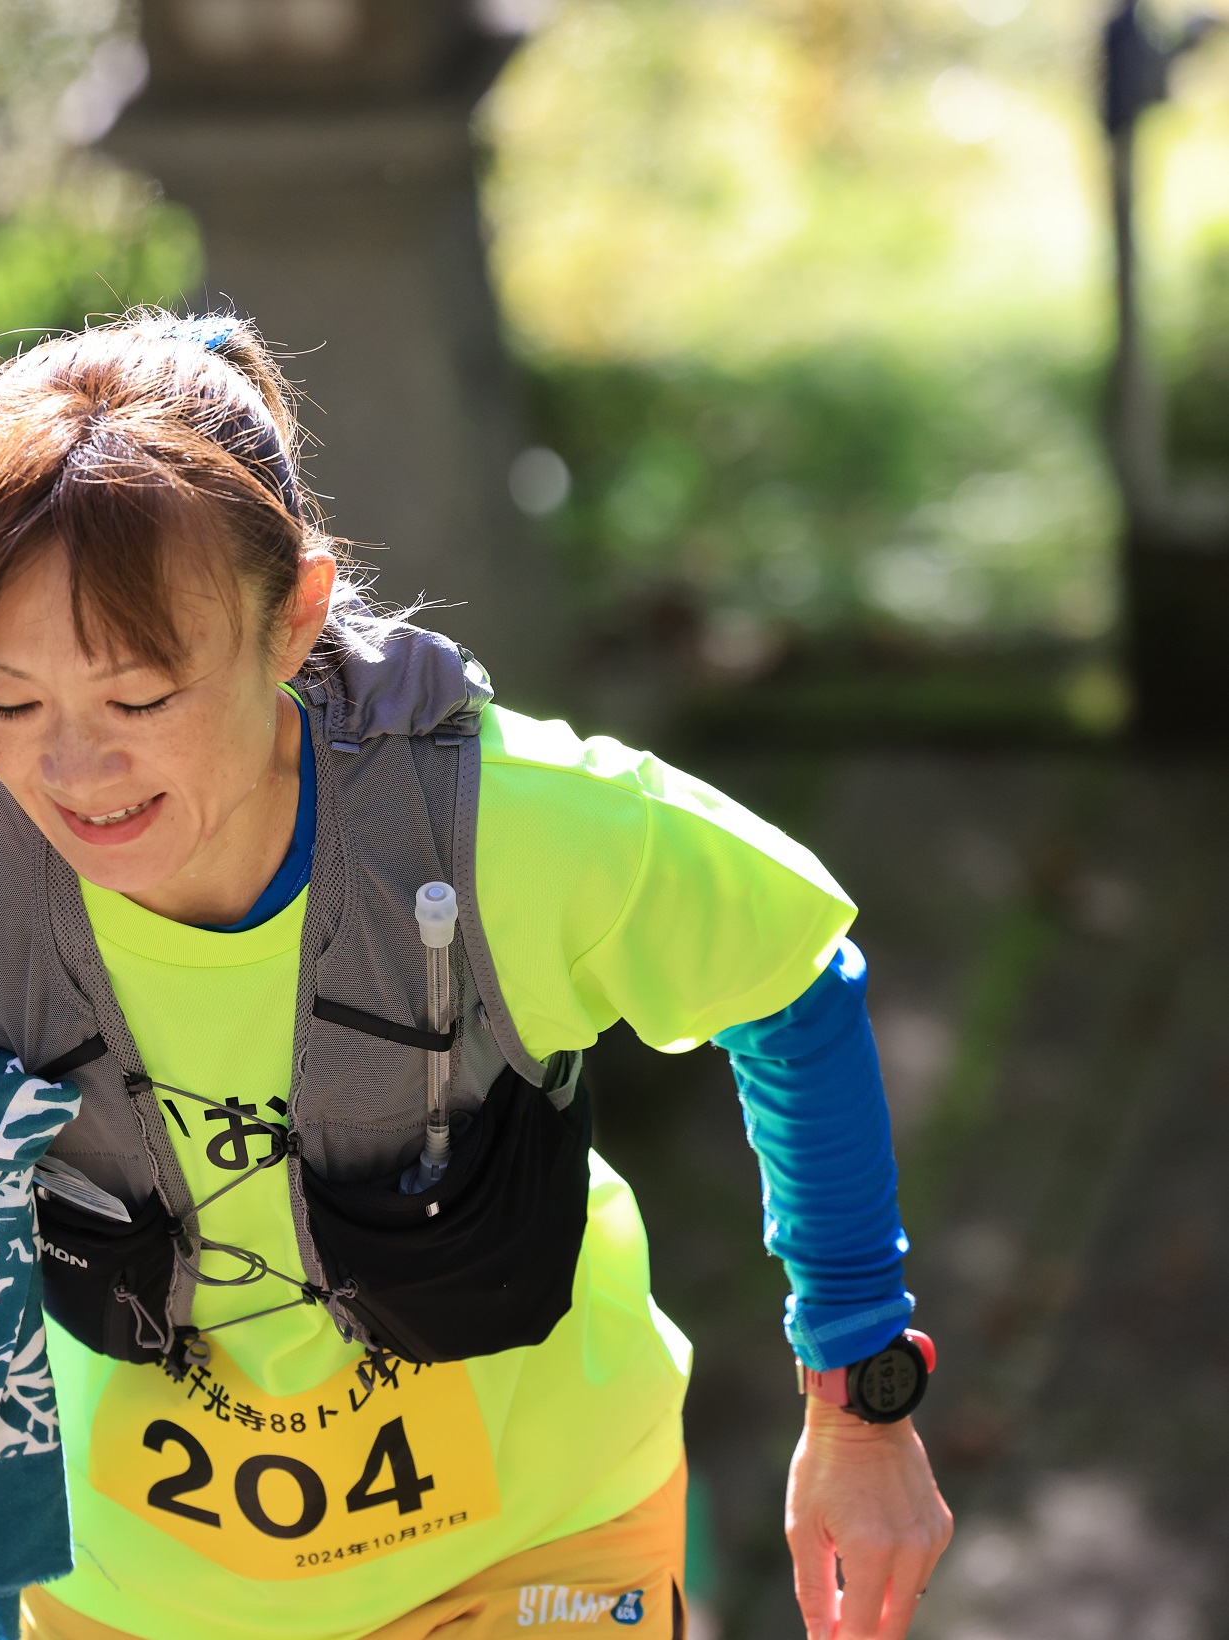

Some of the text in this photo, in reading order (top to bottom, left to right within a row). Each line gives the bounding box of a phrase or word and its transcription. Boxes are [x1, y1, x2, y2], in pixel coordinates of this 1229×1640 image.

[879, 1355, 896, 1408] 19:23
[142, 1416, 435, 1539] 204
[295, 1511, 468, 1567] 2024年10月27日
